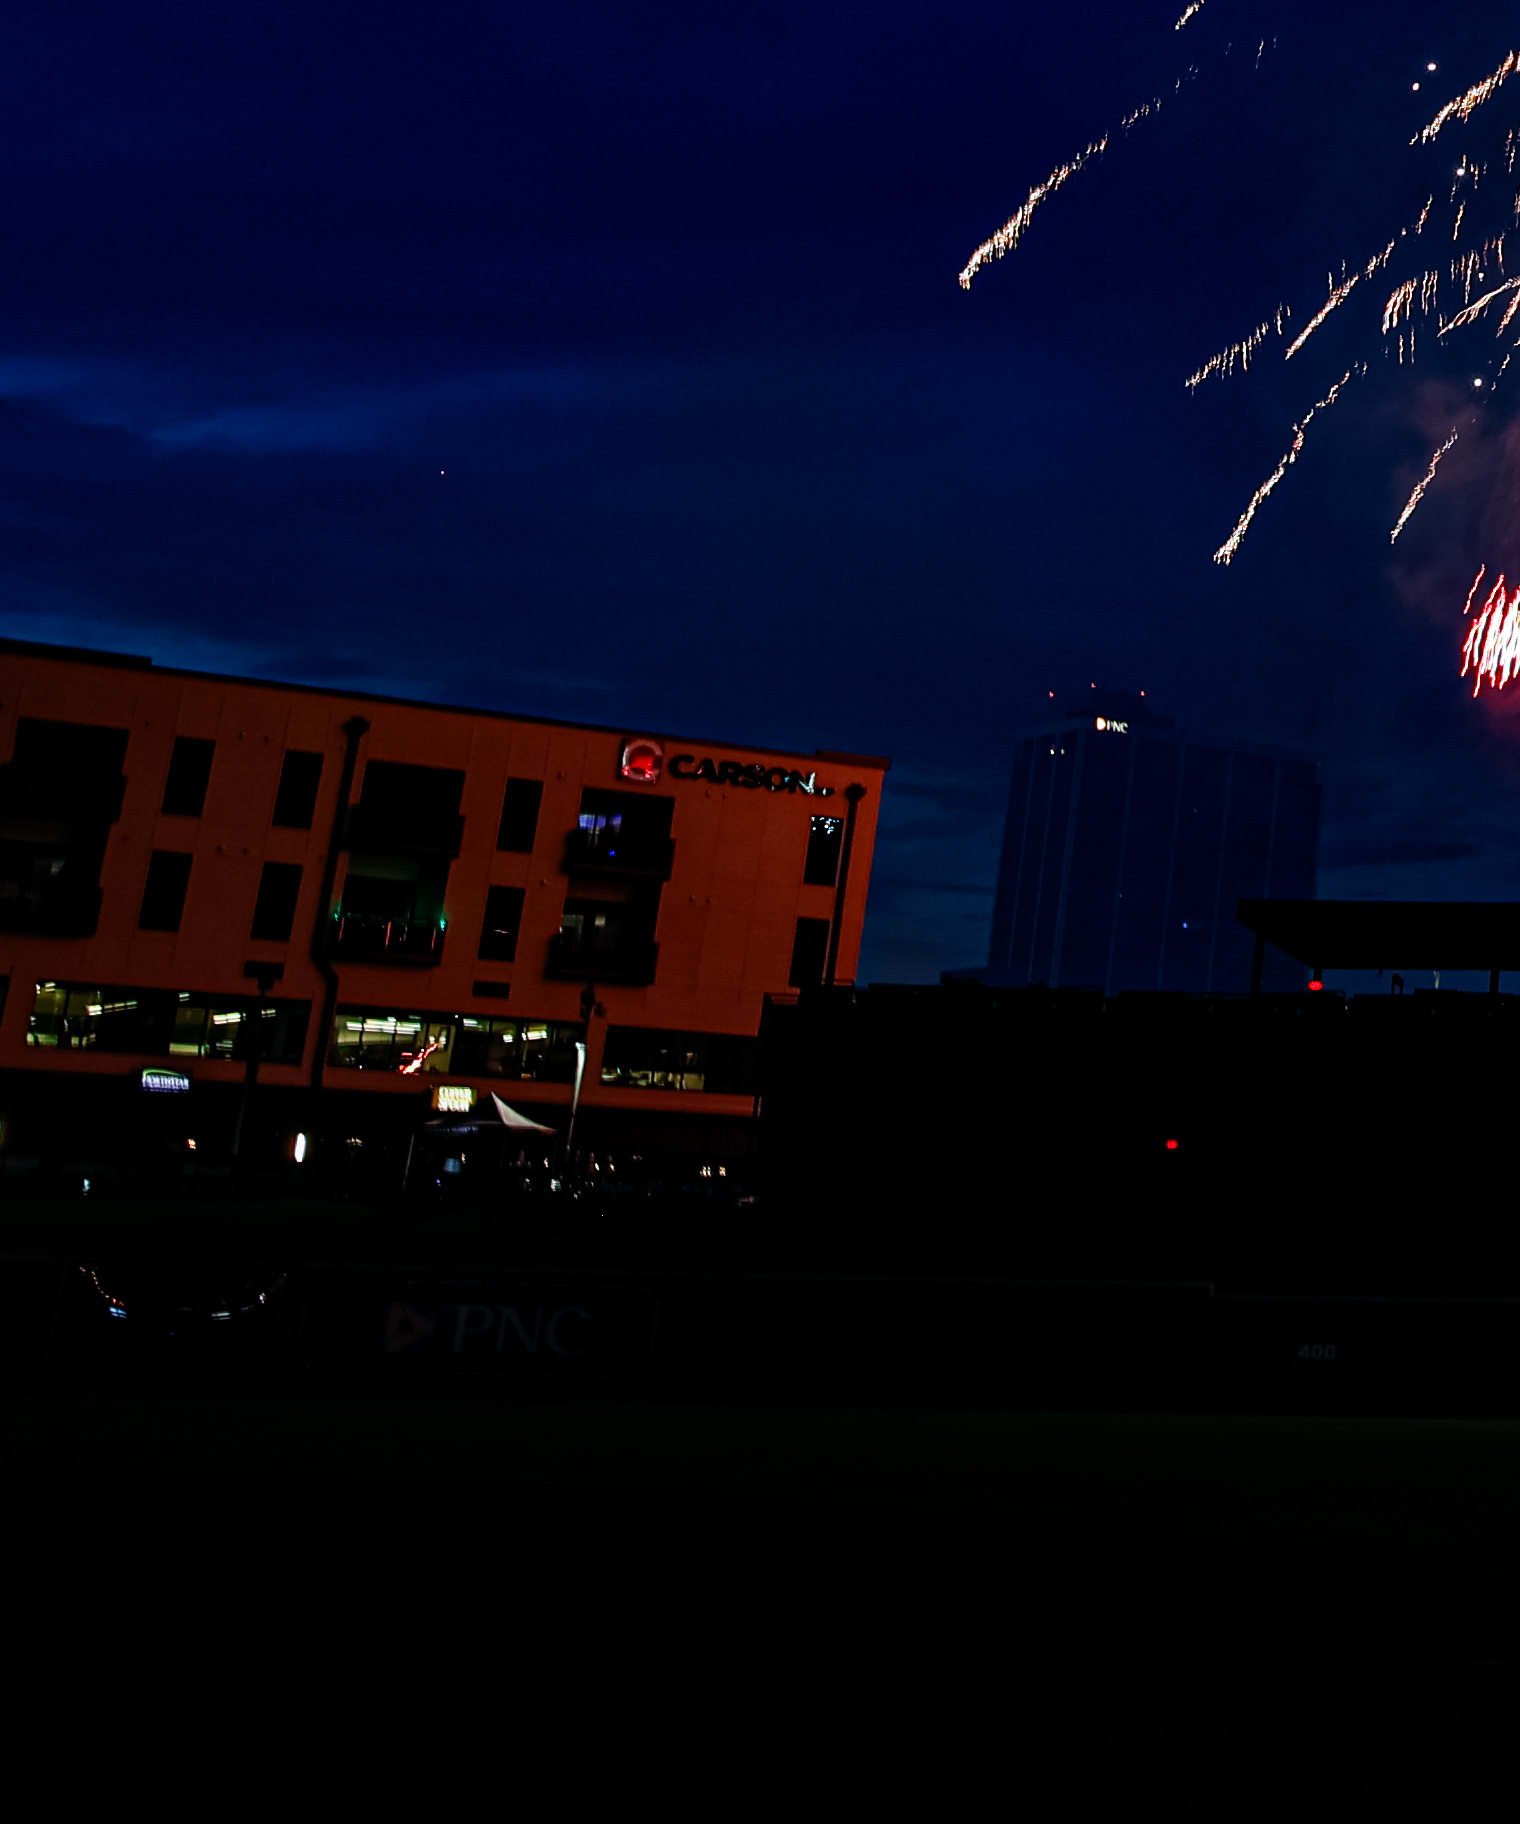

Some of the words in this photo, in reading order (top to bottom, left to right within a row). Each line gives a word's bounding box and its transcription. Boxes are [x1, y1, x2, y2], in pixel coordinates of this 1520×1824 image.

[1106, 719, 1129, 734] PNC
[667, 753, 818, 795] CARSON
[450, 1302, 593, 1360] PNC
[1296, 1342, 1338, 1360] 400
